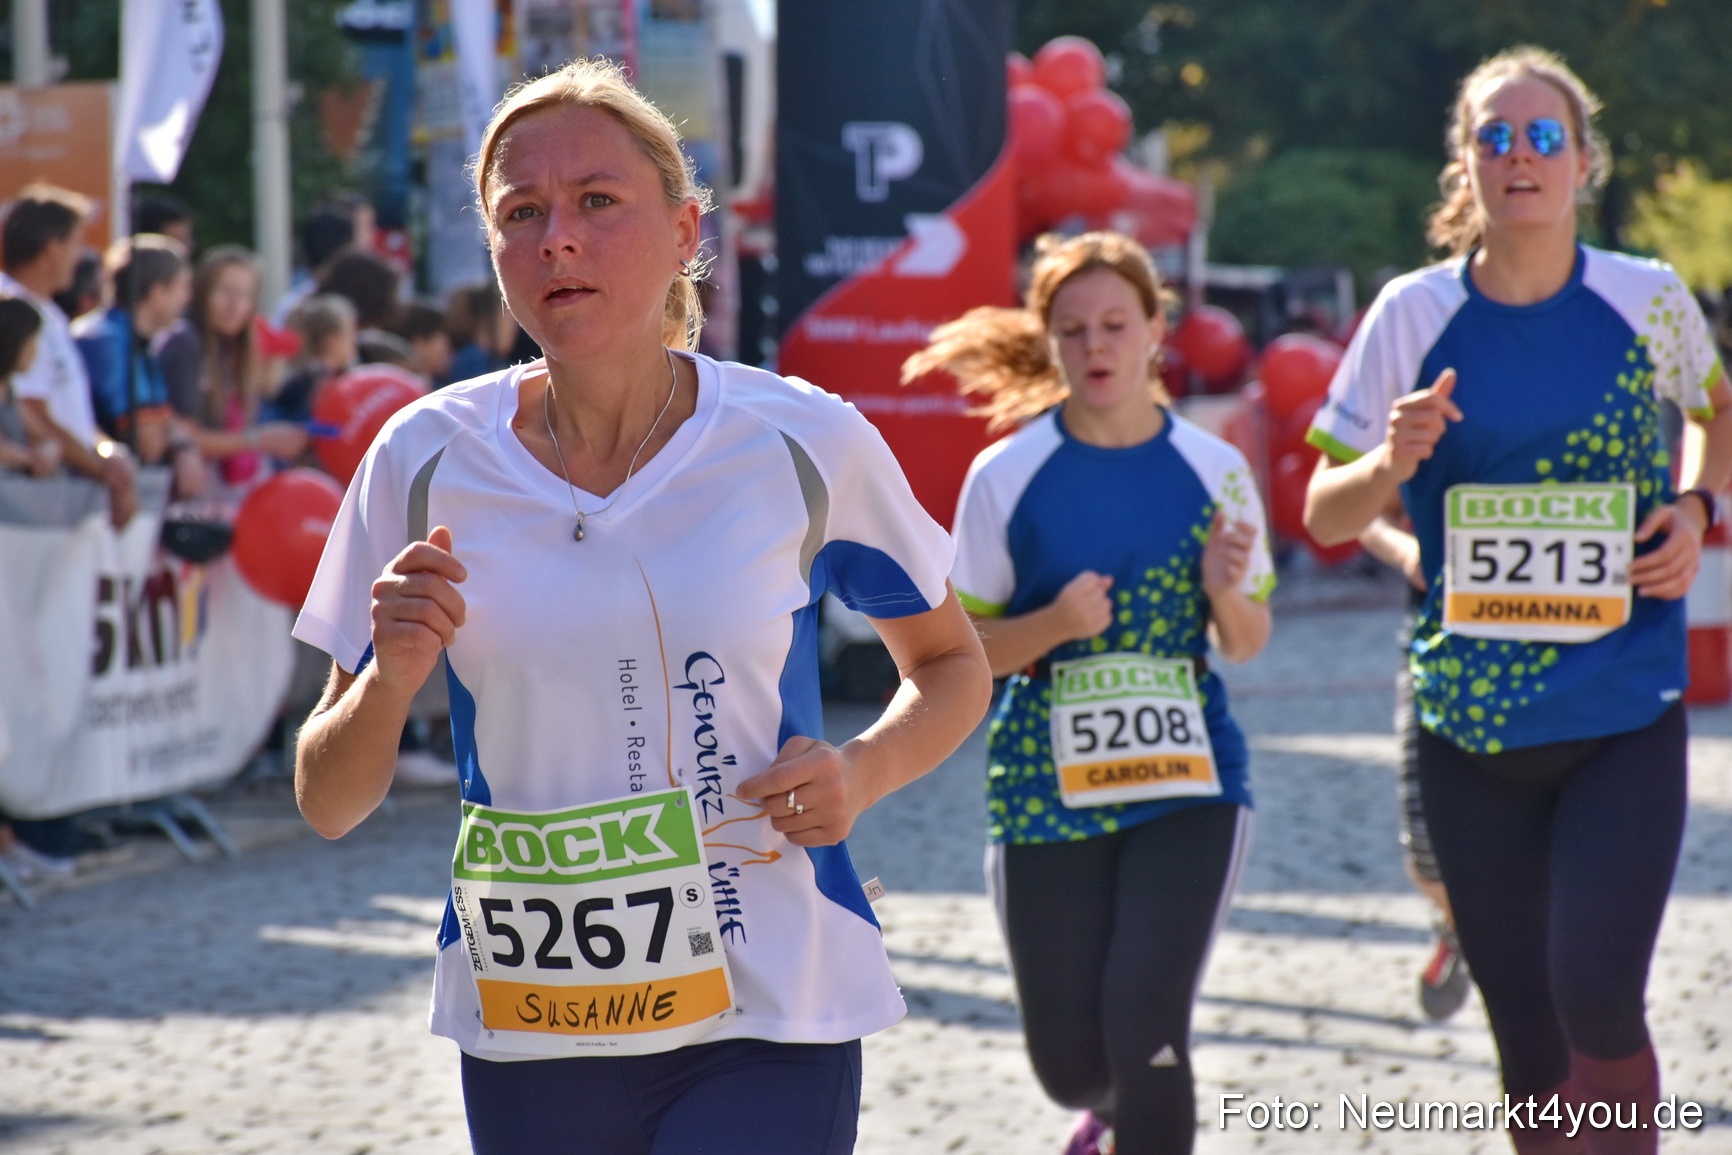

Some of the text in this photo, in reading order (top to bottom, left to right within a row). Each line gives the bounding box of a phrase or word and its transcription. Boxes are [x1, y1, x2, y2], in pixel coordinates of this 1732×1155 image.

[1465, 495, 1607, 520] BOCK
[1469, 538, 1607, 585] 5213
[1471, 600, 1603, 622] JOHANNA
[618, 658, 642, 711] Hotel
[1067, 667, 1174, 693] BOCK
[1072, 705, 1191, 753] 5208
[1086, 760, 1191, 786] CAROLIN
[466, 812, 663, 869] BOCK
[686, 888, 699, 902] S
[479, 886, 675, 970] 5267
[516, 983, 677, 1031] SUSANNE
